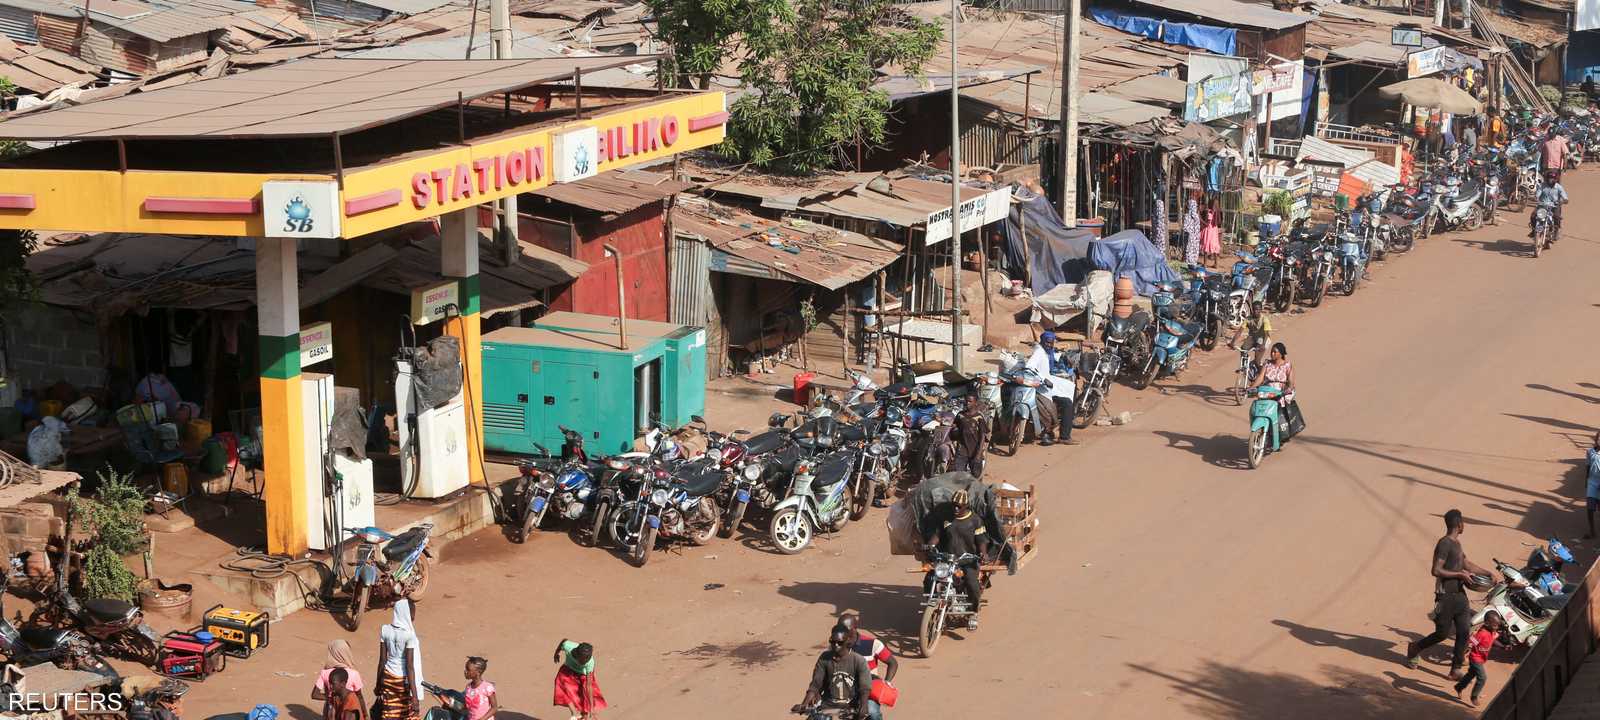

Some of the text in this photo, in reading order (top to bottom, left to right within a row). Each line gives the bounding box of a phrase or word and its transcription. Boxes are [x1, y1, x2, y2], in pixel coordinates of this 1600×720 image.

[572, 159, 587, 175] SB
[411, 147, 545, 209] STATION
[283, 212, 314, 233] SB
[929, 200, 975, 224] NOSTRAAMIS
[309, 345, 329, 359] GASOIL
